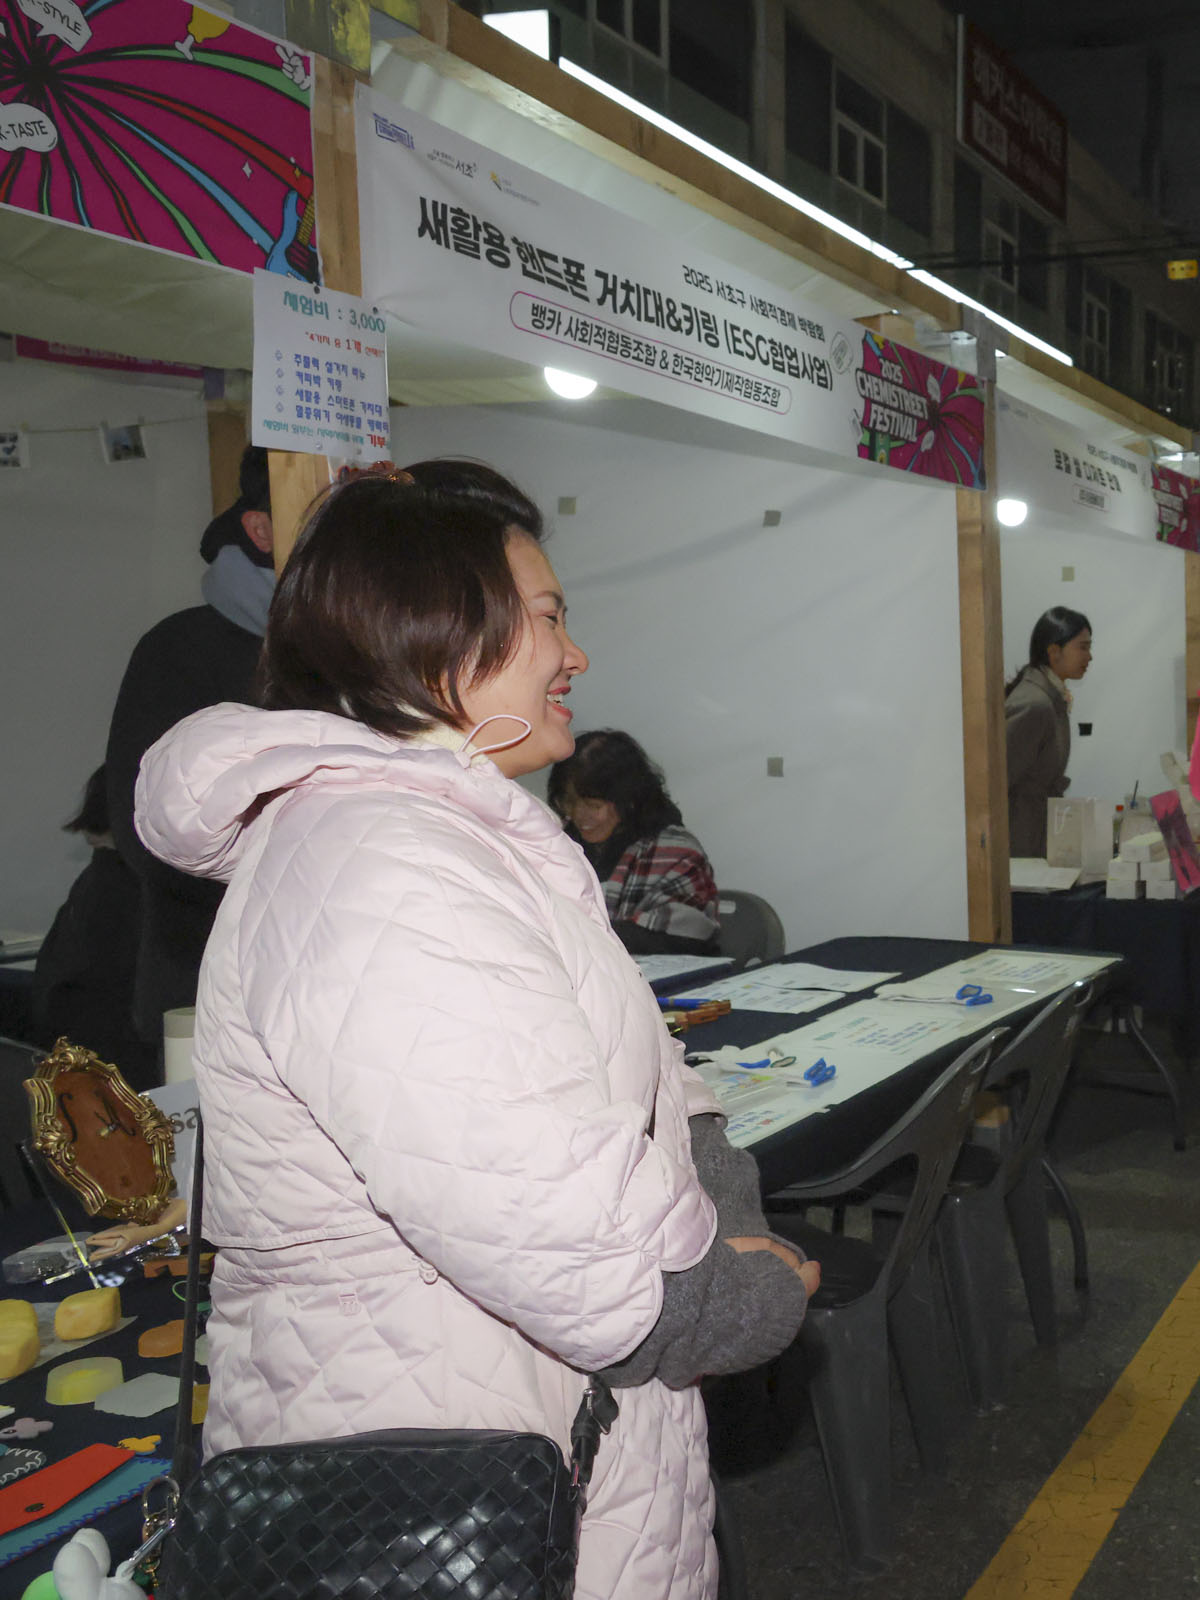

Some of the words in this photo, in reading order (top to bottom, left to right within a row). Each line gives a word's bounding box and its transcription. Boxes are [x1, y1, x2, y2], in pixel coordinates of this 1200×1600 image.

[418, 196, 511, 269] 새활용
[510, 236, 590, 303] 핸드폰
[594, 268, 721, 348] 거치대&키링
[724, 319, 833, 391] (ESG협업사업)
[682, 265, 713, 294] 2025
[716, 280, 747, 309] 서초구
[750, 294, 798, 332] 사회적경제
[798, 315, 826, 343] 박람회
[349, 309, 386, 334] 3,000
[531, 302, 562, 335] 뱅카
[564, 315, 657, 368] 사회적협동조합
[659, 349, 669, 370] &
[672, 353, 781, 408] 한국현악기제작협동조합
[879, 358, 904, 384] 2025
[857, 370, 929, 420] CHEMISTREET
[869, 403, 919, 442] FESTIVAL
